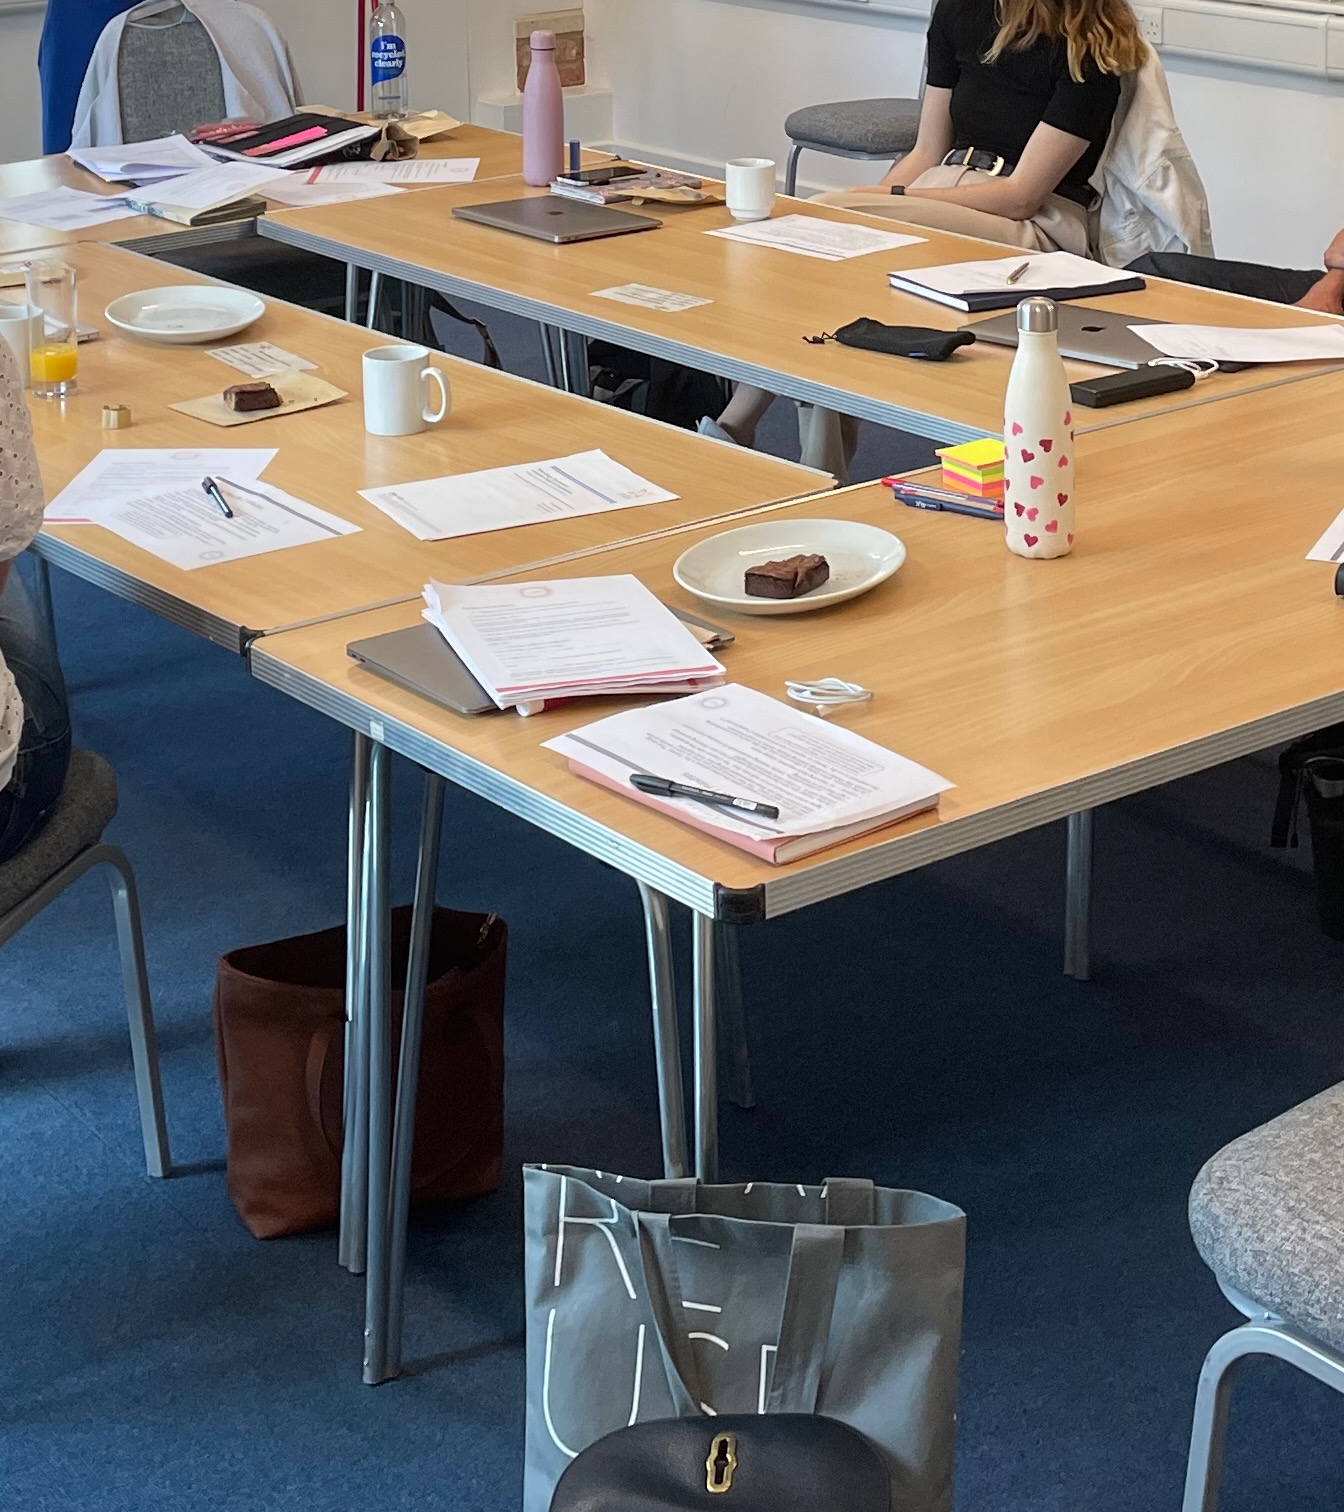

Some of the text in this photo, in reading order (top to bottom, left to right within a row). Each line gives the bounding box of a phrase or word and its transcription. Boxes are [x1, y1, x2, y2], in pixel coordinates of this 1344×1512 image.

[381, 40, 396, 50] I'm
[371, 49, 405, 60] recycled
[374, 59, 403, 68] clearly
